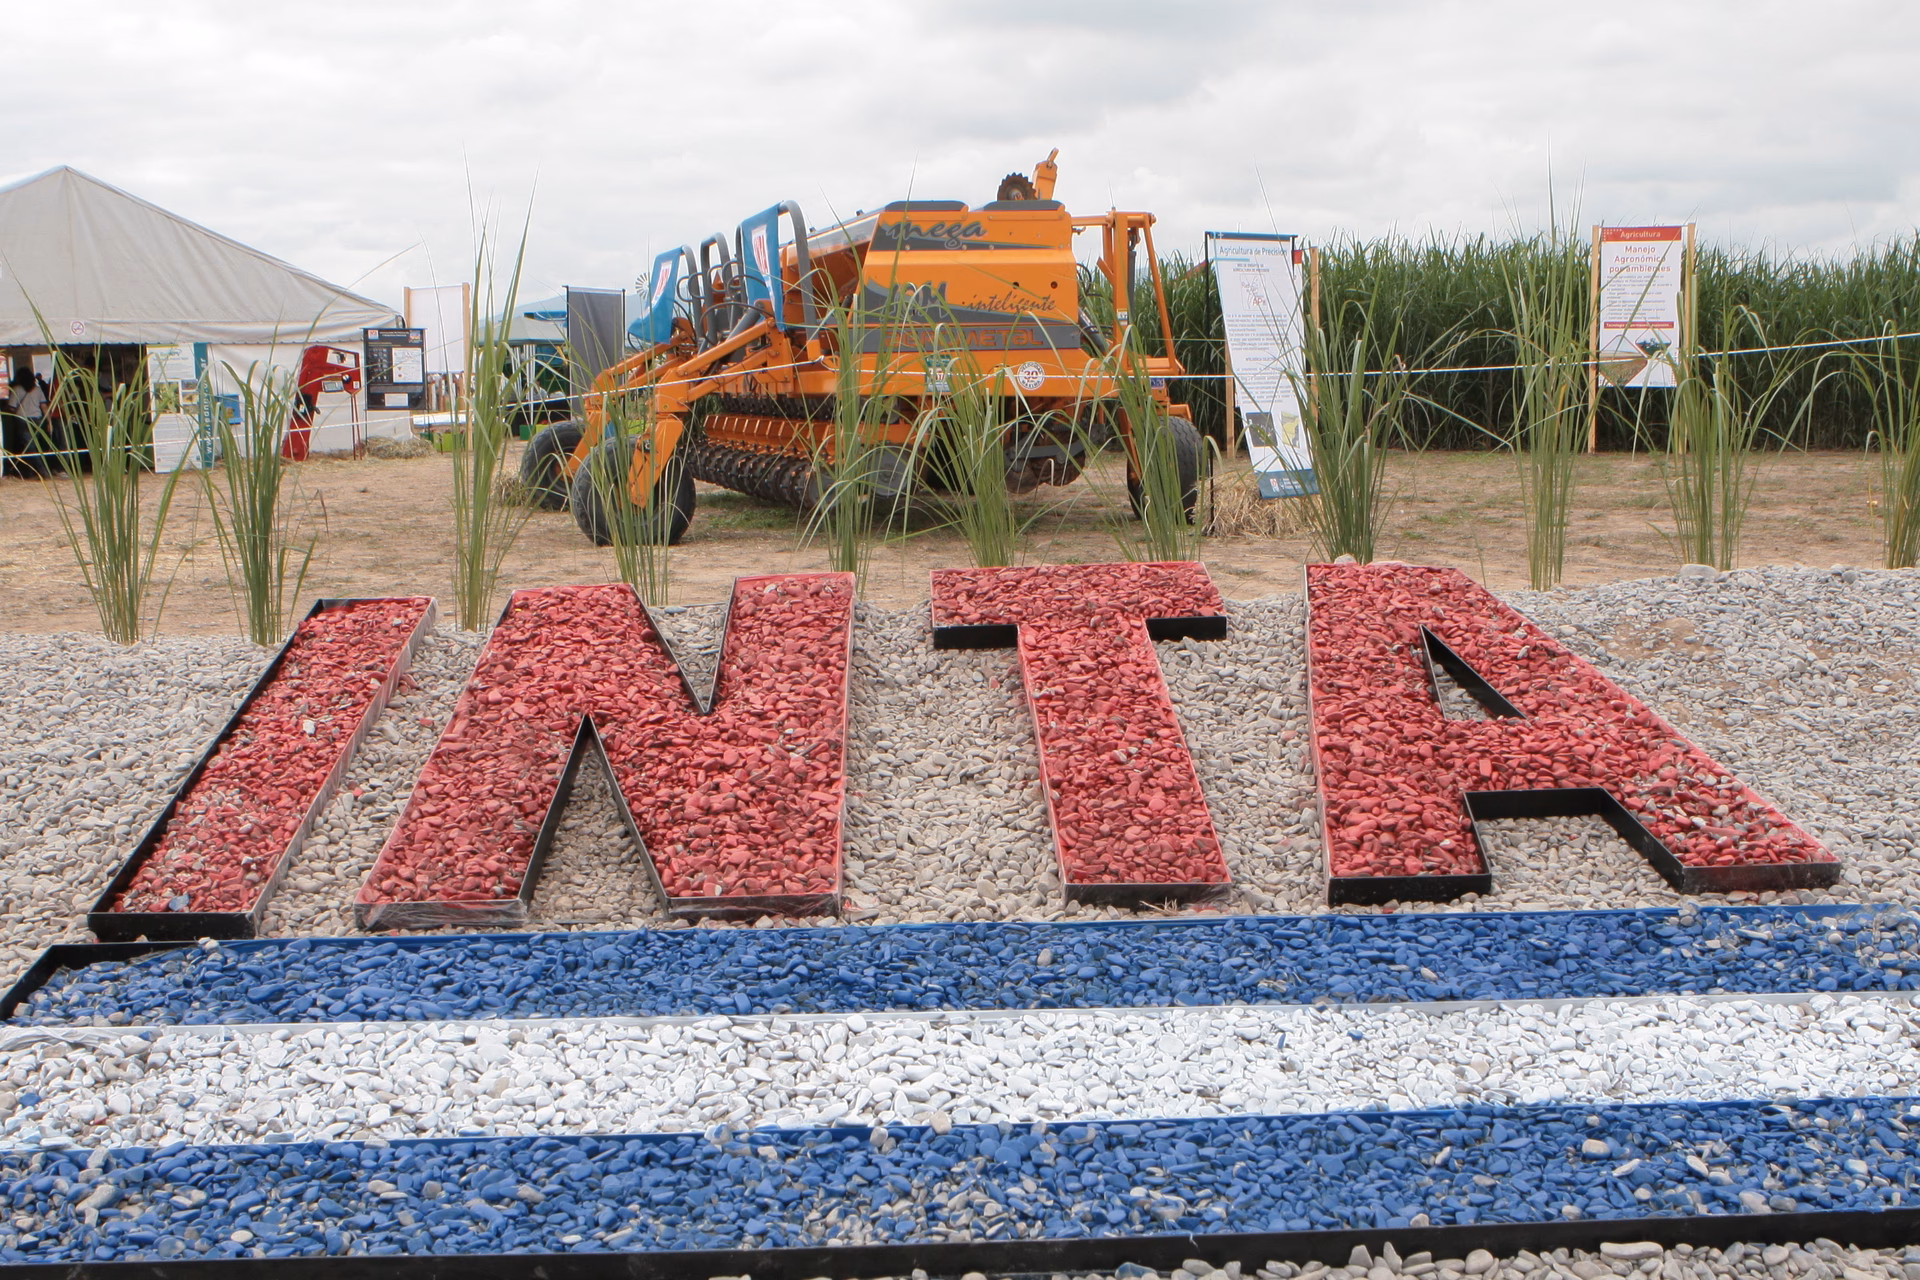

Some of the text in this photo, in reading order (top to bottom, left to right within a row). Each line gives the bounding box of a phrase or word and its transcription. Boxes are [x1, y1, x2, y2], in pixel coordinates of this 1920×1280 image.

[885, 219, 988, 250] mega
[1620, 231, 1661, 239] Agricultura
[1219, 246, 1253, 257] Agricultura
[1254, 247, 1261, 256] de
[1624, 245, 1656, 254] Manejo
[967, 290, 1056, 317] inteligente
[1024, 370, 1038, 380] 30
[87, 560, 1842, 938] INTA
